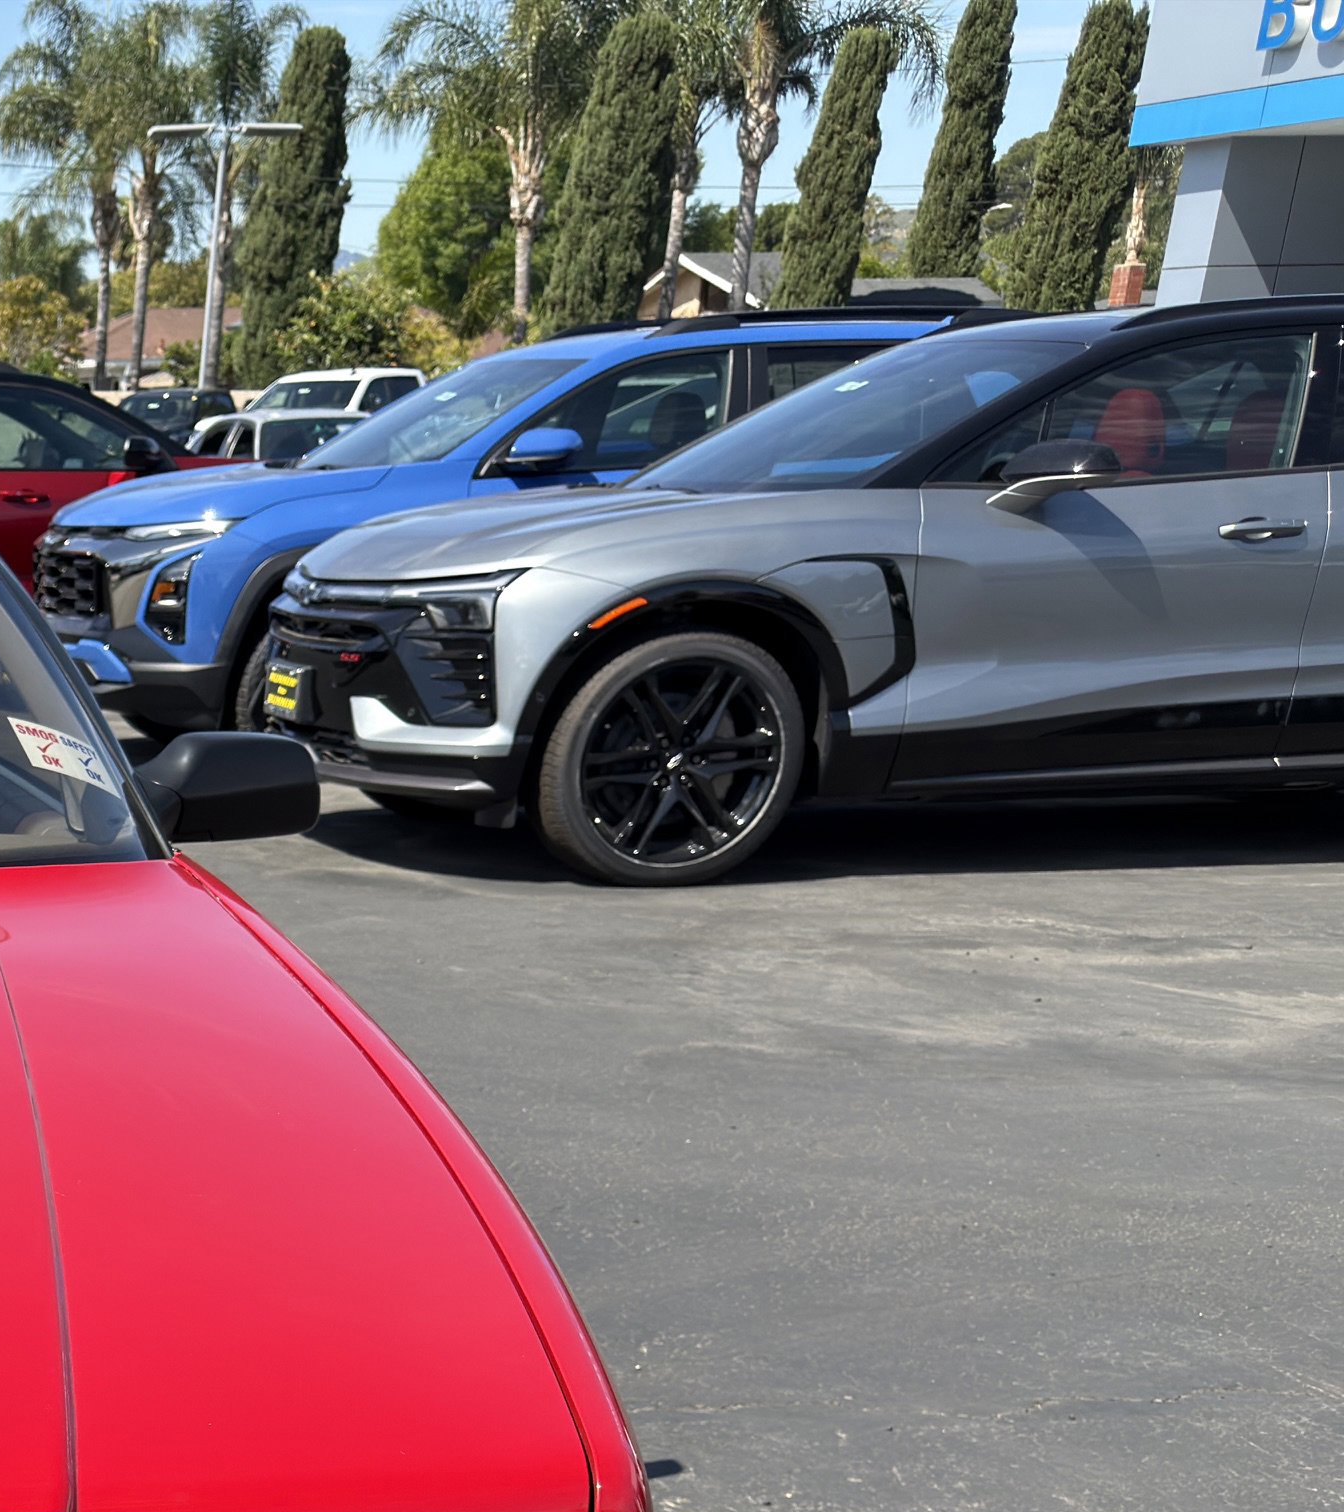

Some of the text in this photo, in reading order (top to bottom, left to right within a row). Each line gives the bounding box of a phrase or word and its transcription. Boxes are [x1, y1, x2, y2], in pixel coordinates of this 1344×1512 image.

[15, 724, 97, 760] SMOG SAFETY
[42, 754, 106, 784] OK OK
